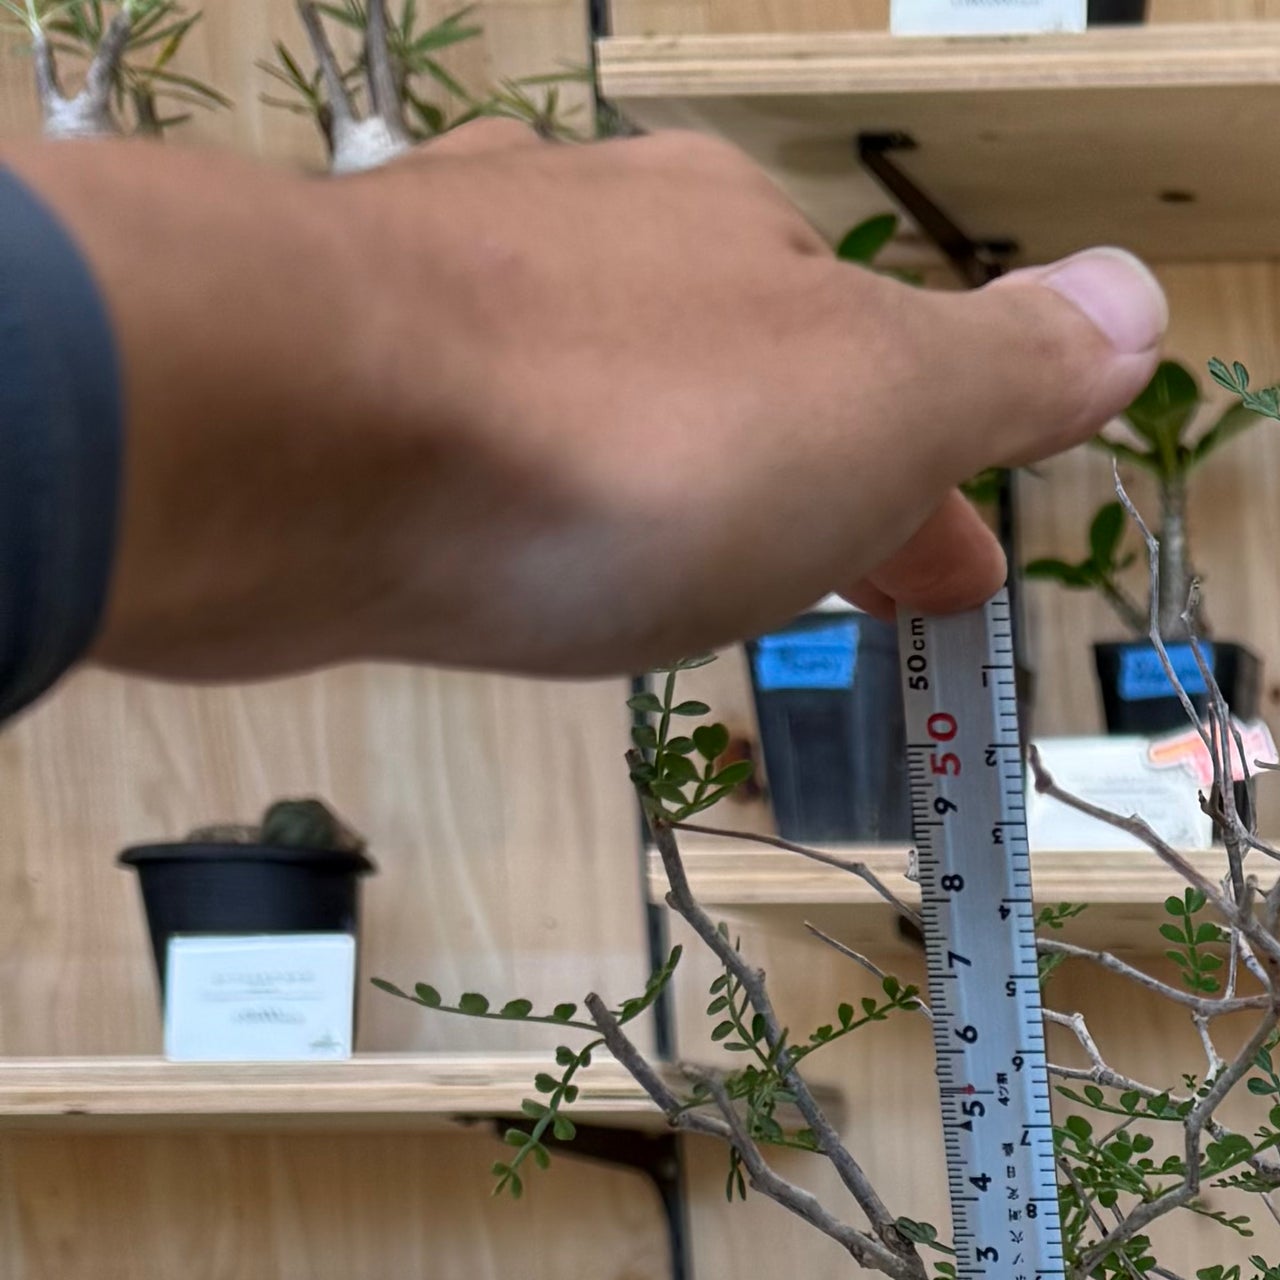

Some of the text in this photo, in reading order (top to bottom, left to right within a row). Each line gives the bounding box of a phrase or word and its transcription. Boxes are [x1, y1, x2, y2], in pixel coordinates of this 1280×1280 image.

[907, 617, 928, 690] 50cm
[934, 797, 958, 816] 9
[941, 874, 964, 892] 8
[948, 951, 972, 968] 7
[985, 750, 997, 767] 2
[992, 829, 1003, 844] 3
[998, 906, 1010, 920] 4
[1006, 982, 1017, 997] 5
[1012, 1057, 1024, 1072] 6
[1019, 1130, 1032, 1146] 7
[1026, 1203, 1038, 1219] 8
[955, 1025, 978, 1044] 6
[962, 1100, 985, 1117] 5
[970, 1173, 992, 1191] 4
[976, 1246, 999, 1262] 3
